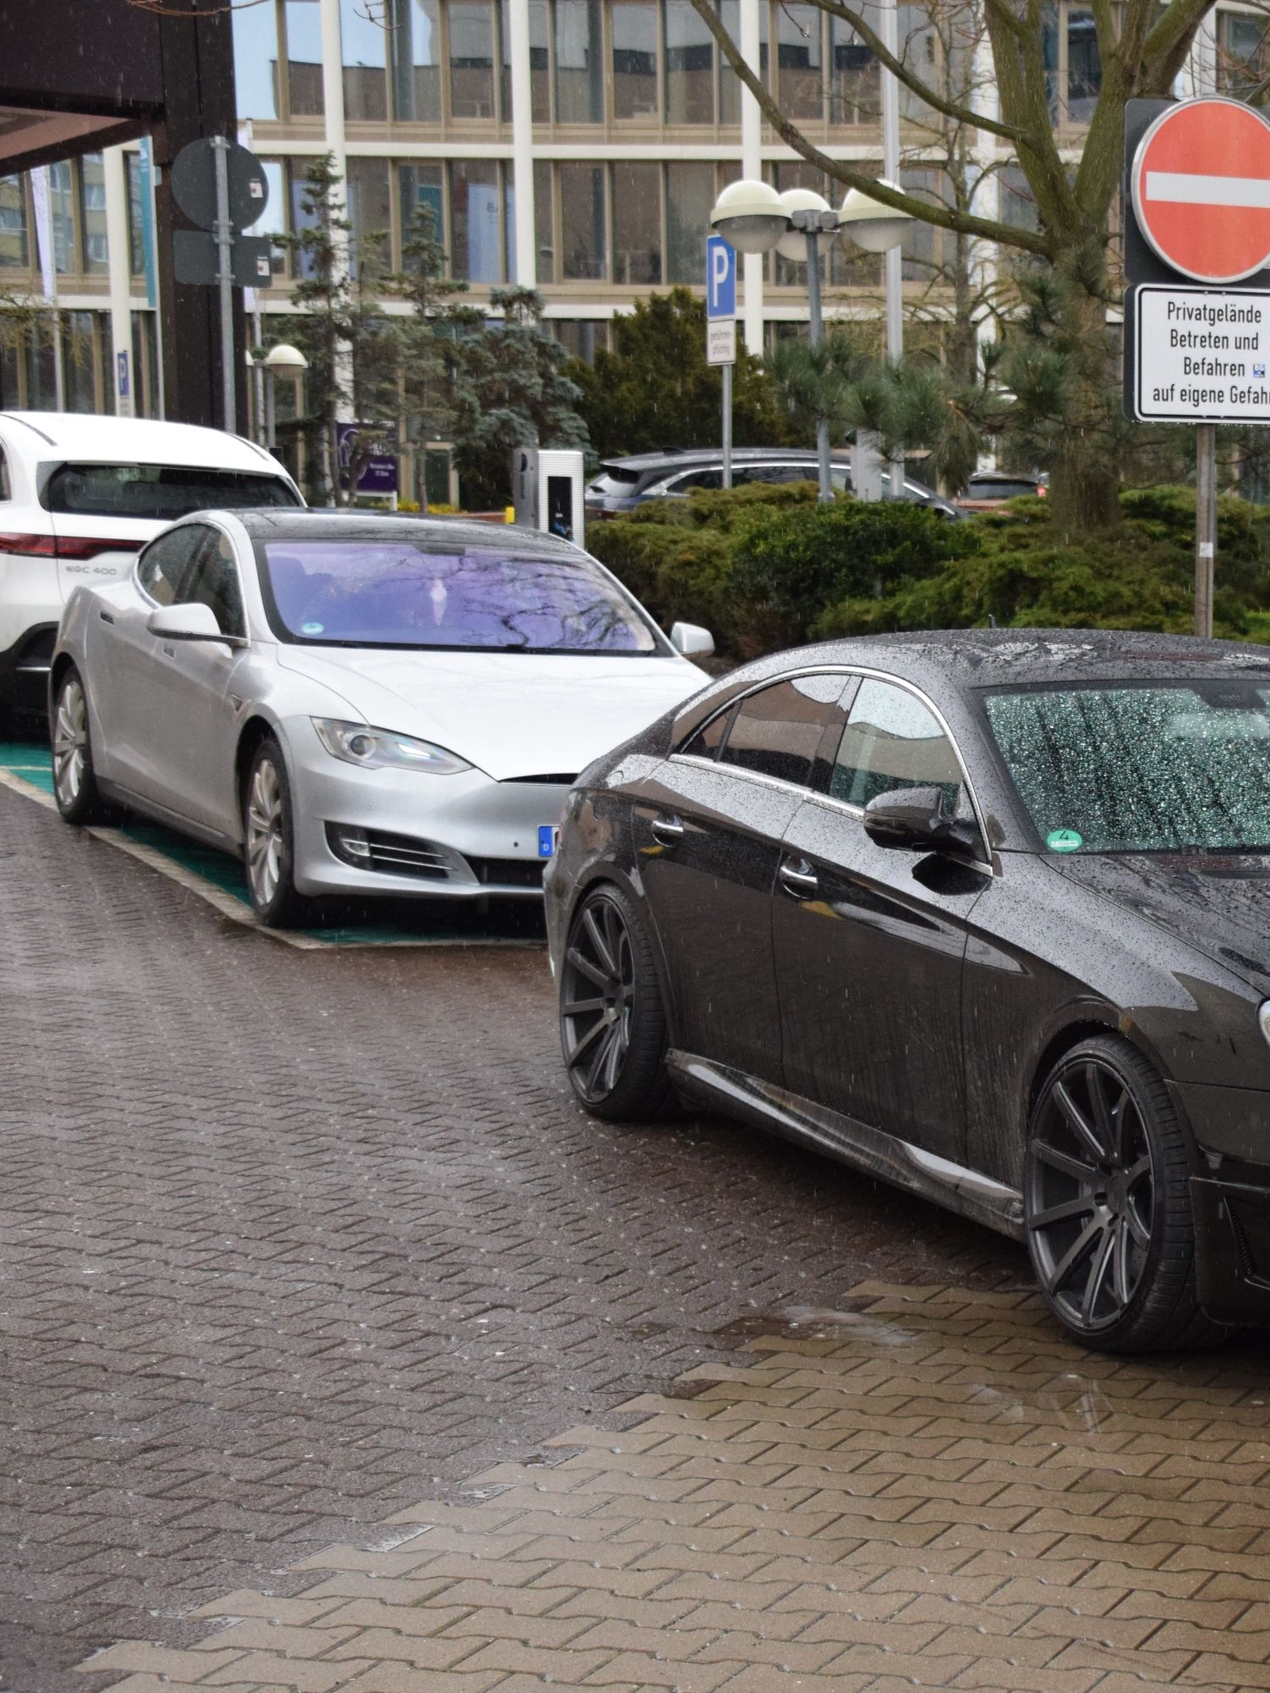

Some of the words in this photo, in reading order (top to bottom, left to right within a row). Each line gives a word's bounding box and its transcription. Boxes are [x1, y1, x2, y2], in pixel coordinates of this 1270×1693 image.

[713, 246, 729, 307] P
[1167, 301, 1262, 327] Privatgelände
[1170, 328, 1229, 350] Betreten
[1234, 332, 1259, 351] und
[1183, 356, 1245, 378] Befahren
[1152, 383, 1175, 403] auf
[1179, 384, 1225, 408] eigene
[1059, 830, 1070, 841] 4
